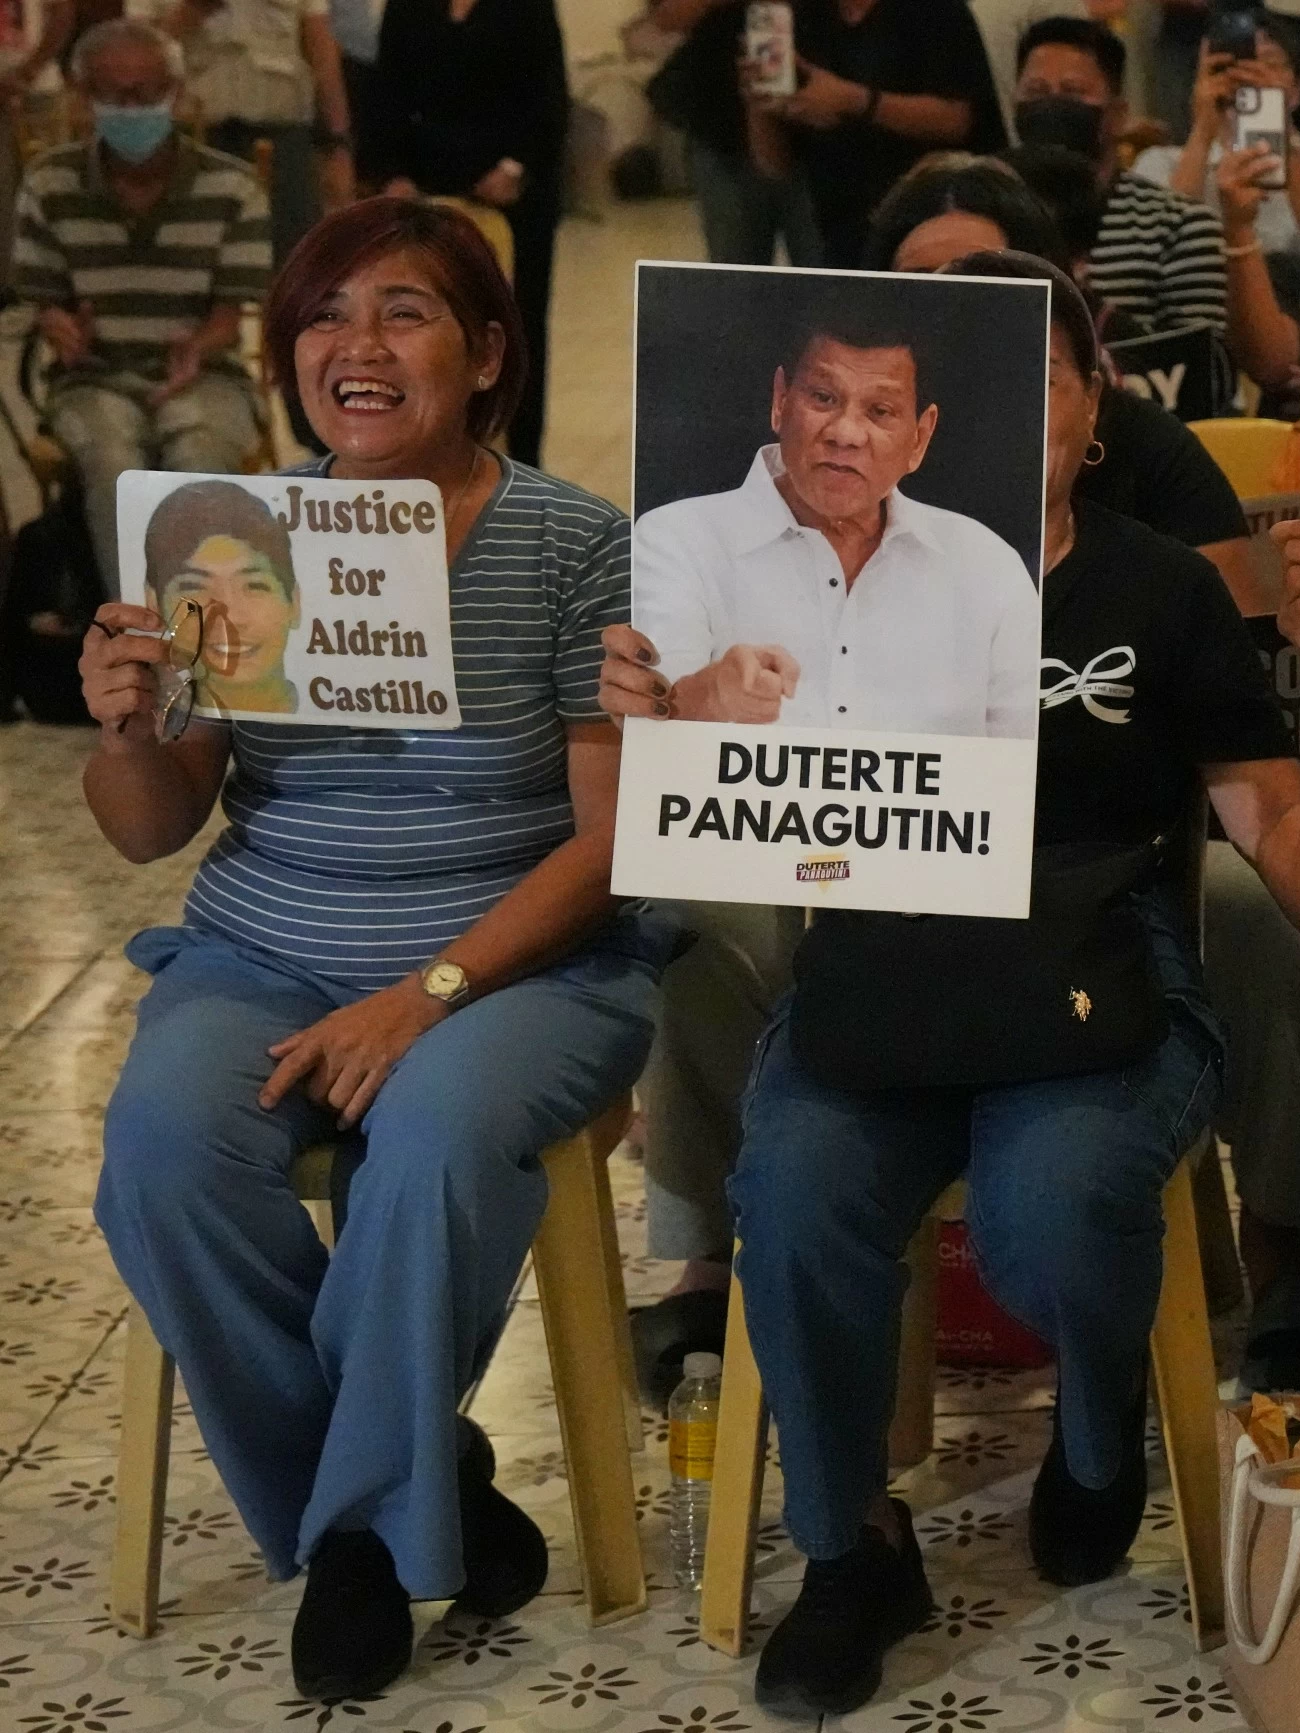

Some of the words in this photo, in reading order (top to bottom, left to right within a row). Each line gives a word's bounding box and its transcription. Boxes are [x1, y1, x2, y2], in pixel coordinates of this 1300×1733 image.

[277, 486, 436, 535] Justice
[328, 557, 386, 597] for
[306, 618, 428, 658] Aldrin
[309, 676, 448, 716] Castillo
[718, 741, 941, 796] DUTERTE
[658, 794, 990, 856] PANAGUTIN!
[796, 860, 850, 871] DUTERTE
